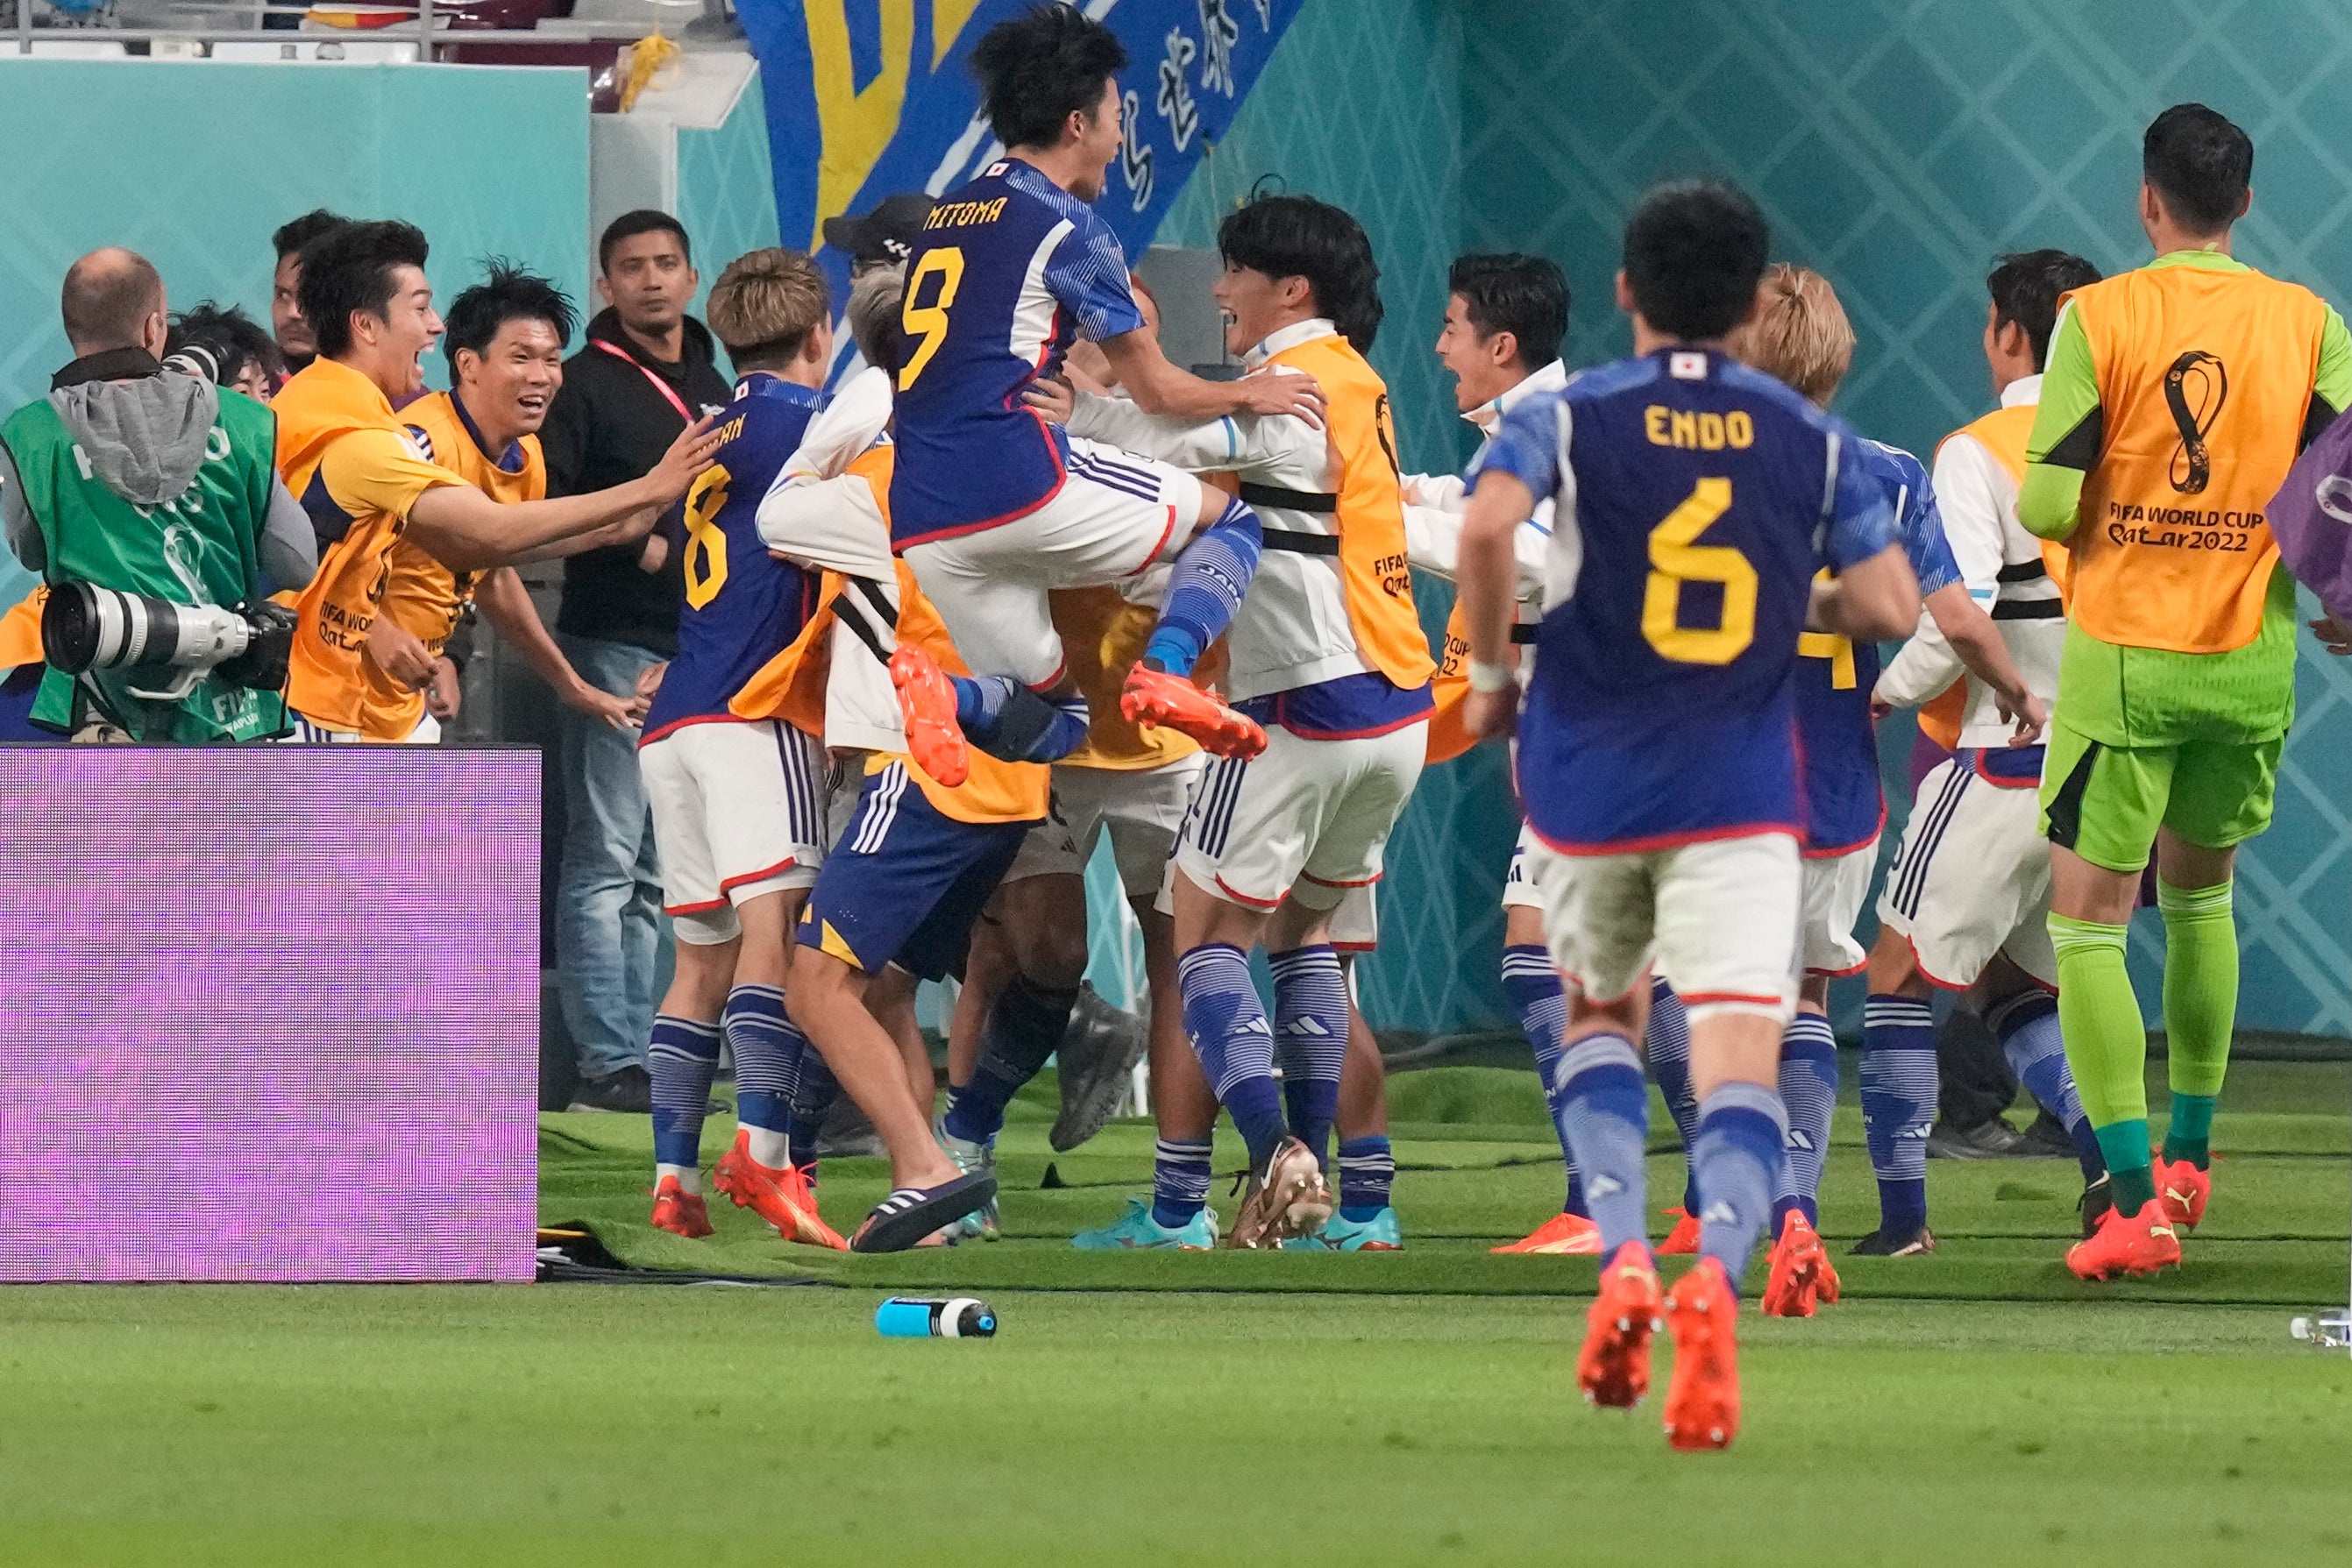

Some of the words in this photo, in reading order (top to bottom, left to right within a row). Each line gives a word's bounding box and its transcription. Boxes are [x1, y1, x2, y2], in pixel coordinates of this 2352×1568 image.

[923, 197, 1007, 231] MITOMA
[899, 246, 964, 392] 9
[1644, 404, 1754, 451] ENDO
[2110, 501, 2144, 521] FIFA
[2148, 507, 2220, 527] WORLD
[2224, 511, 2264, 529] CUP
[684, 464, 732, 611] 8
[1374, 554, 1404, 577] FIFA
[1640, 477, 1759, 667] 6
[1198, 566, 1243, 613] JAPA
[319, 600, 350, 626] FIFA
[347, 612, 373, 632] WO
[1442, 655, 1459, 677] 22
